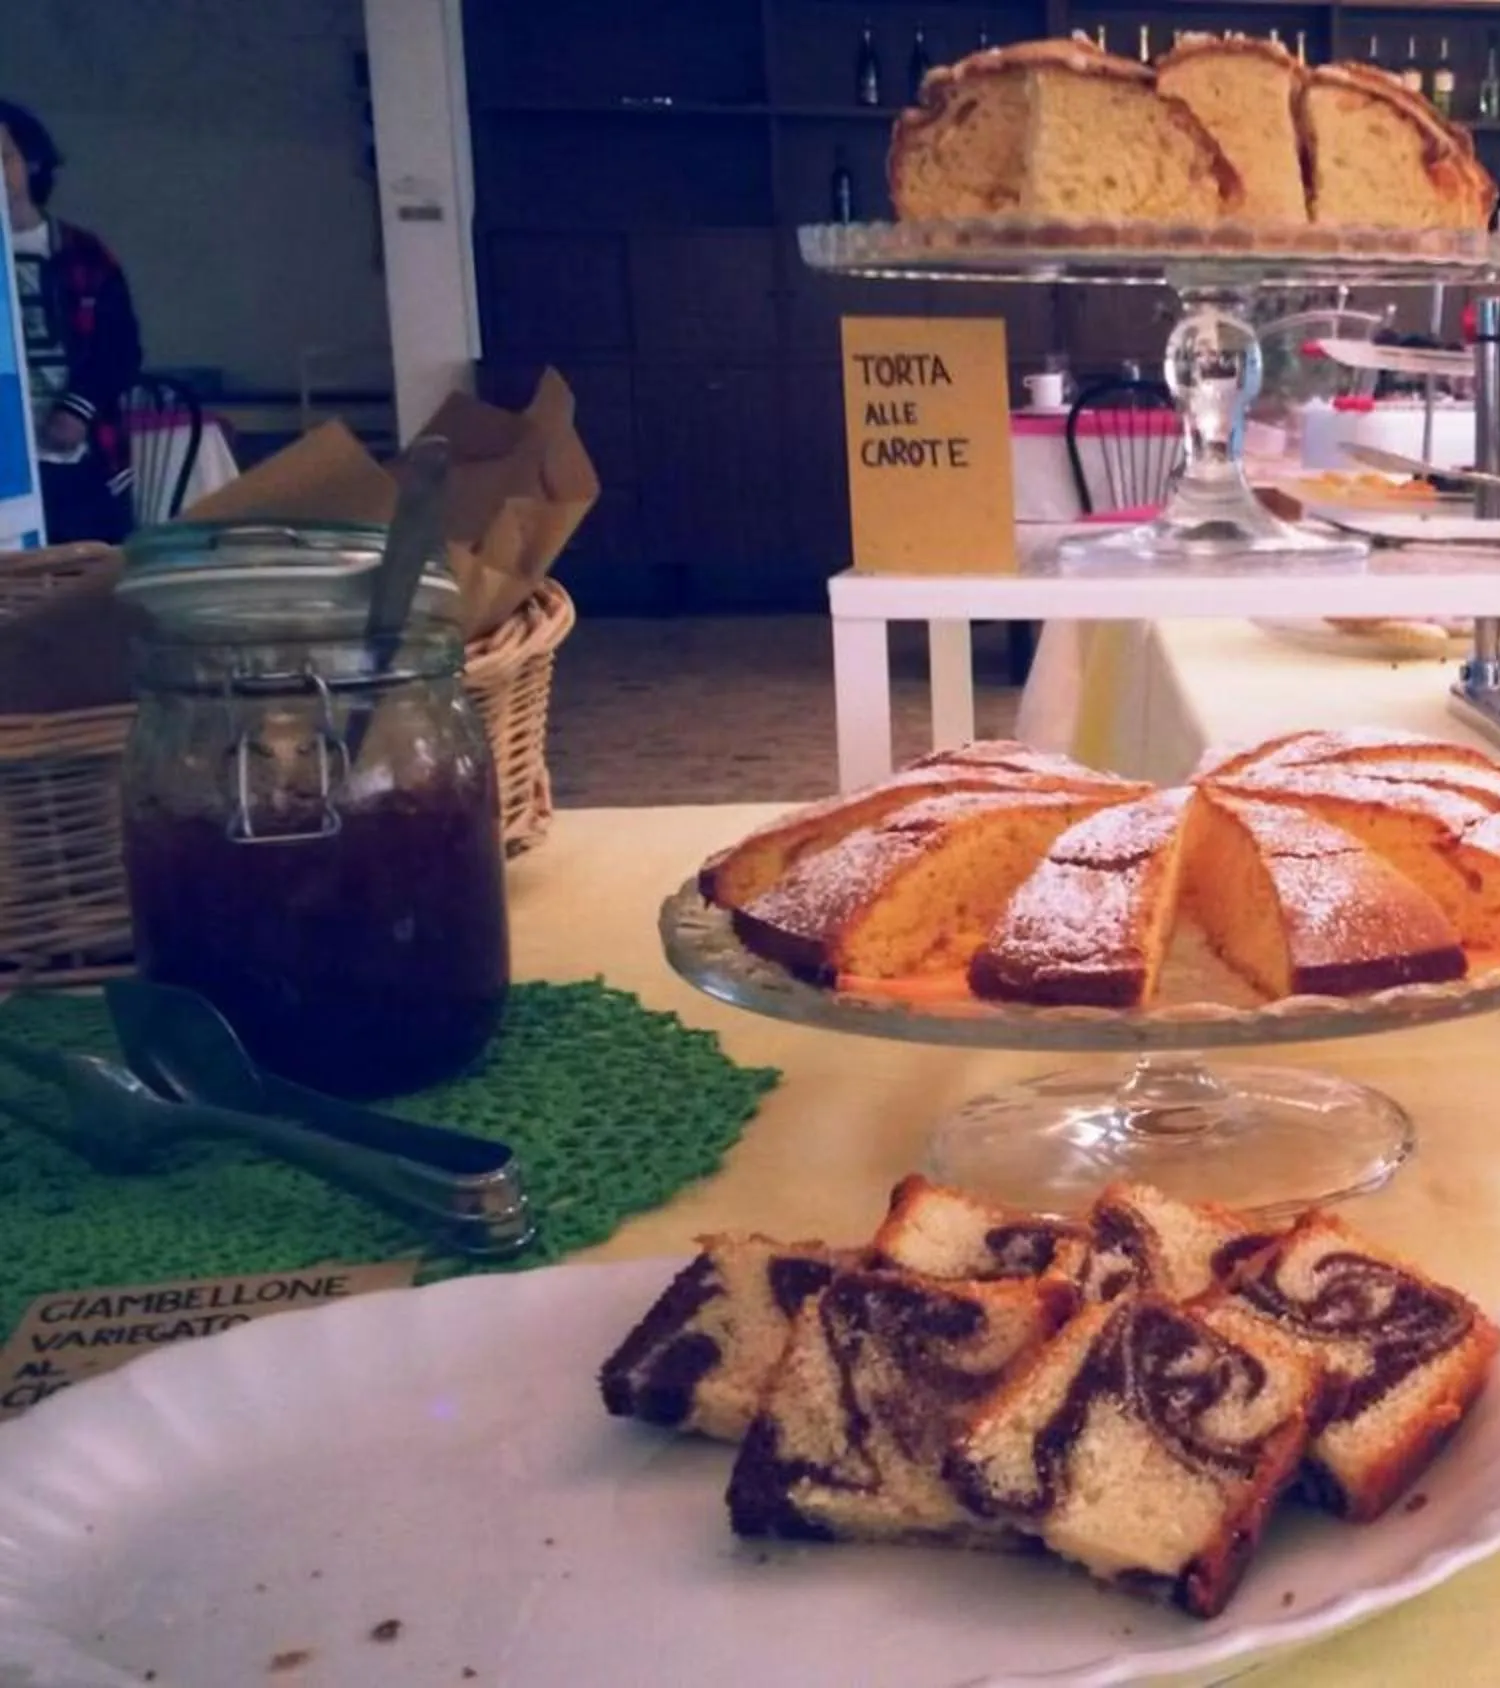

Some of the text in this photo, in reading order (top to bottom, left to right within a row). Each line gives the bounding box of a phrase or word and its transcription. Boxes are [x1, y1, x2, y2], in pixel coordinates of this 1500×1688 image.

[852, 353, 952, 386] TORTA
[864, 402, 917, 426] ALLE
[861, 438, 969, 468] CAROTE
[39, 1275, 351, 1323] CIAMBELLONE
[14, 1360, 65, 1380] AL
